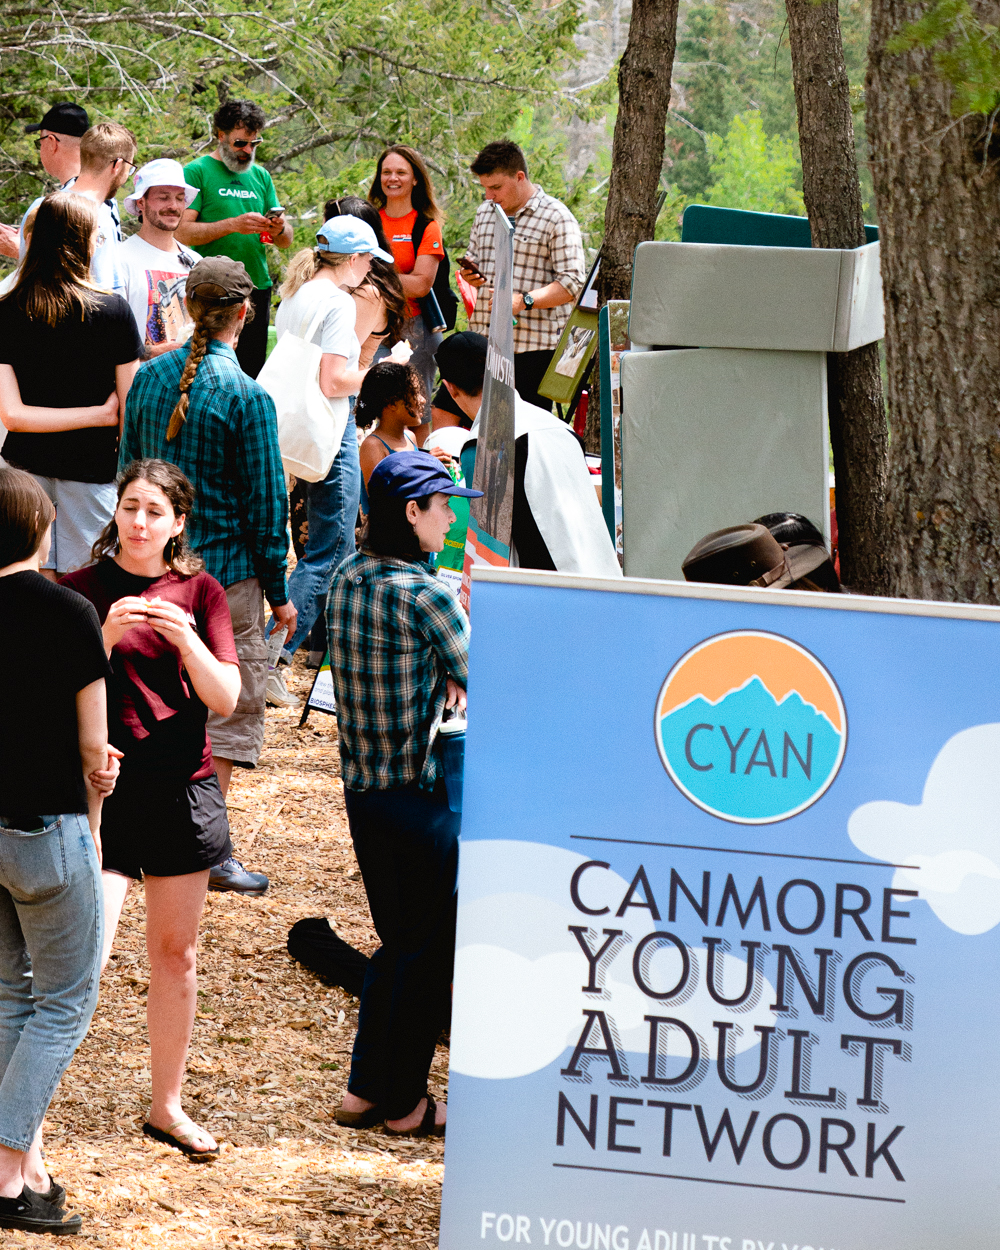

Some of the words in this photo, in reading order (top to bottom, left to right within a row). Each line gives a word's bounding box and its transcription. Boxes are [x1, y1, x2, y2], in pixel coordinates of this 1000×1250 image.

[218, 188, 258, 200] CAMBA
[310, 697, 335, 709] BIOSPHE
[684, 722, 814, 781] CYAN
[569, 860, 919, 946] CANMORE
[567, 925, 914, 1030] YOUNG
[560, 1009, 912, 1114] ADULT
[556, 1091, 906, 1182] NETWORK
[480, 1211, 532, 1243] FOR
[539, 1217, 630, 1250] YOUNG
